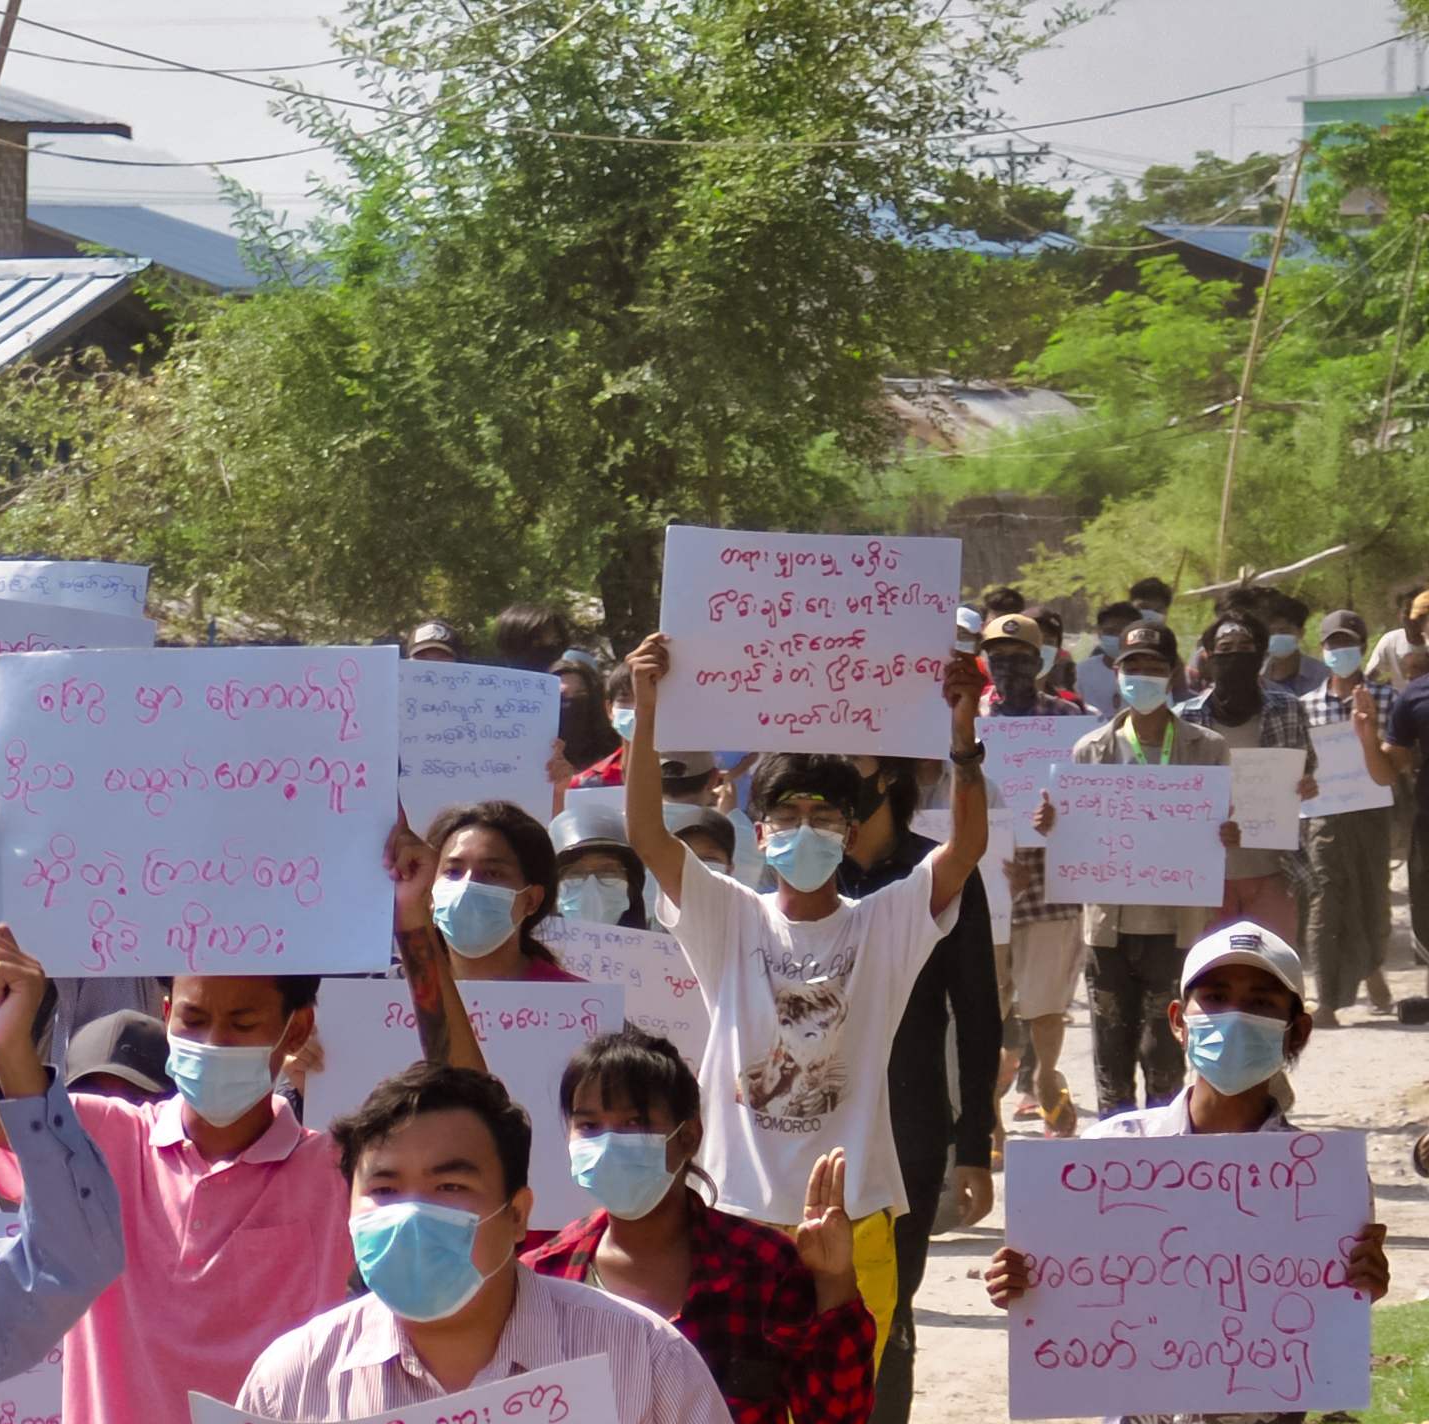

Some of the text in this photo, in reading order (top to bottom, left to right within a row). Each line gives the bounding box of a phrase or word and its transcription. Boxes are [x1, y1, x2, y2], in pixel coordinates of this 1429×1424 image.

[825, 653, 944, 693] ငြိမ်းချမ်းရေ
[1059, 1132, 1338, 1222] ပညာရေးကို
[1149, 1291, 1316, 1403] အလိုမရှိ
